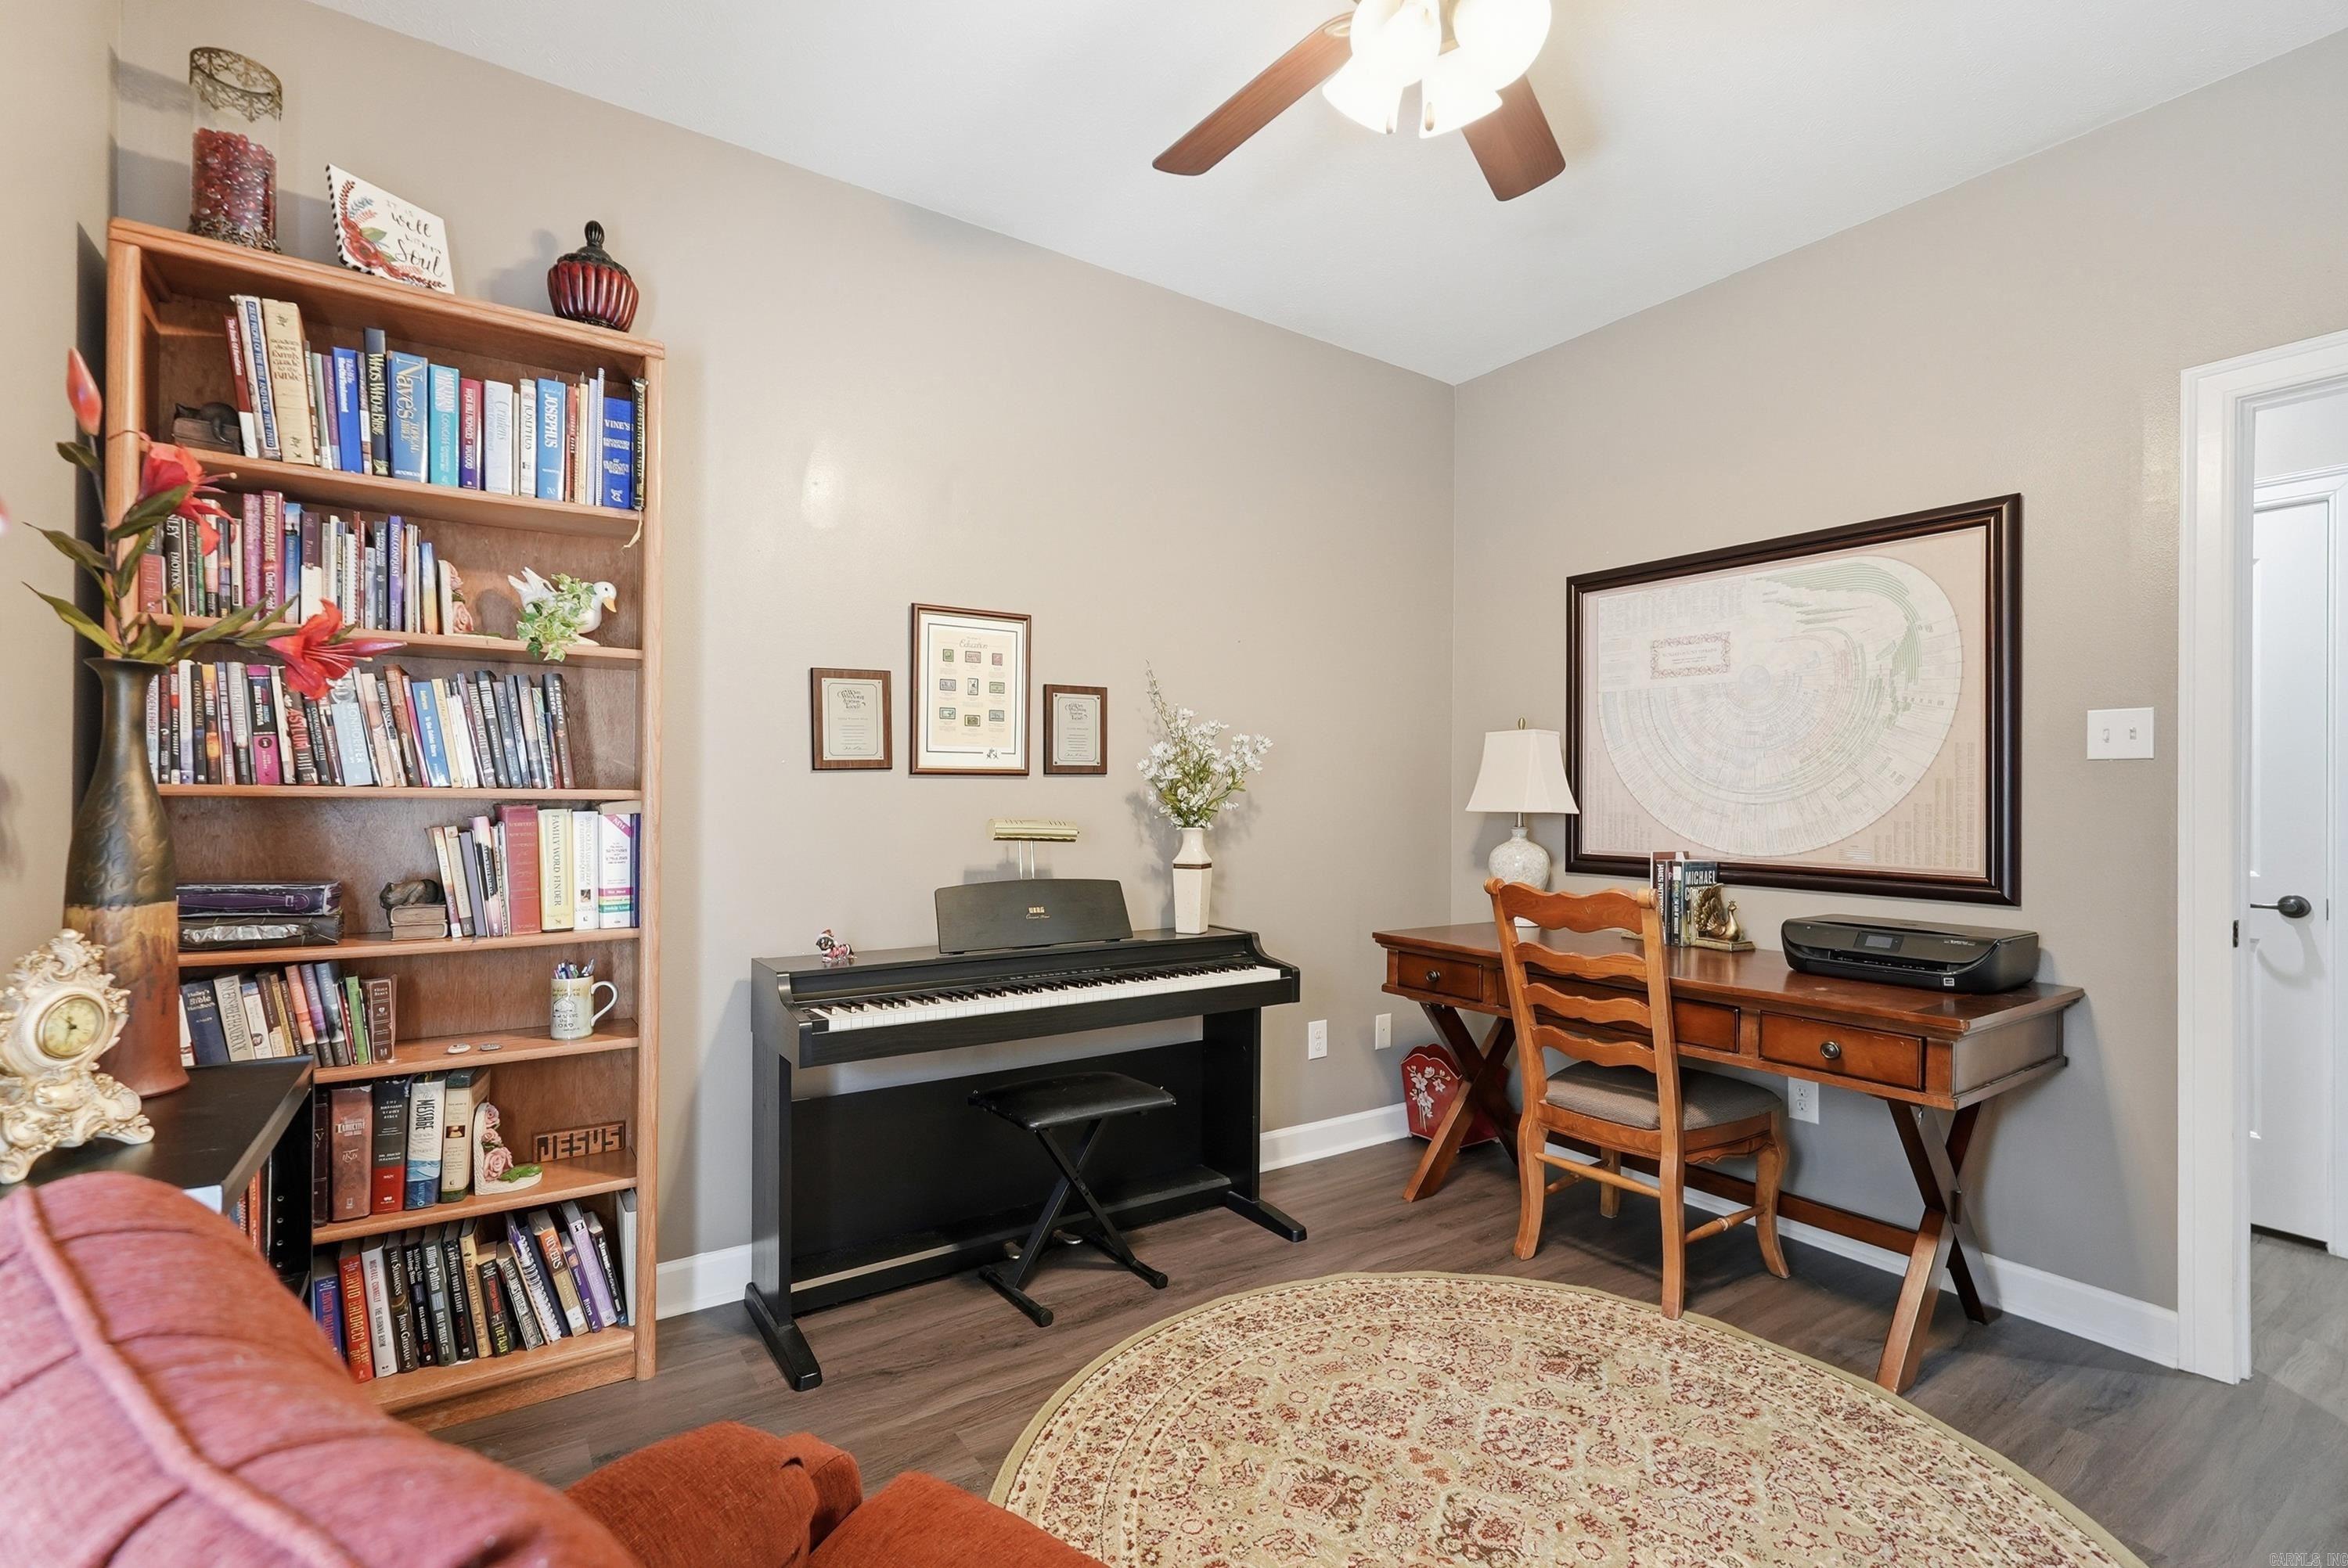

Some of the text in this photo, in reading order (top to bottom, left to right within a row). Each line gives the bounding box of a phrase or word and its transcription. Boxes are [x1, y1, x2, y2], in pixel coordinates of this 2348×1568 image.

[544, 394, 558, 448] JOSEPHUS
[167, 514, 180, 539] NLEY
[147, 712, 157, 736] ENEMY
[286, 708, 312, 750] ASYLUM
[551, 815, 560, 845] FAMILY
[552, 847, 561, 872] WORD
[1685, 870, 1717, 885] MICHAEL
[189, 996, 211, 1005] Bible
[416, 1099, 435, 1130] MESSAGE
[533, 1123, 625, 1163] JESUS
[405, 1250, 415, 1270] Rising
[413, 1248, 422, 1271] Killing
[545, 1235, 563, 1268] RIVERS
[369, 1259, 379, 1281] MICHAEL
[466, 1270, 476, 1286] SECRET
[390, 1251, 411, 1361] THE SUMMONS JOHN GRISHAM
[425, 1246, 448, 1343] Killing Patton BILL O'REILLY
[453, 1293, 463, 1313] ASSAULT
[468, 1287, 479, 1304] TALES
[345, 1273, 365, 1342] DAVID BALDACCI
[322, 1314, 334, 1341] BALDA
